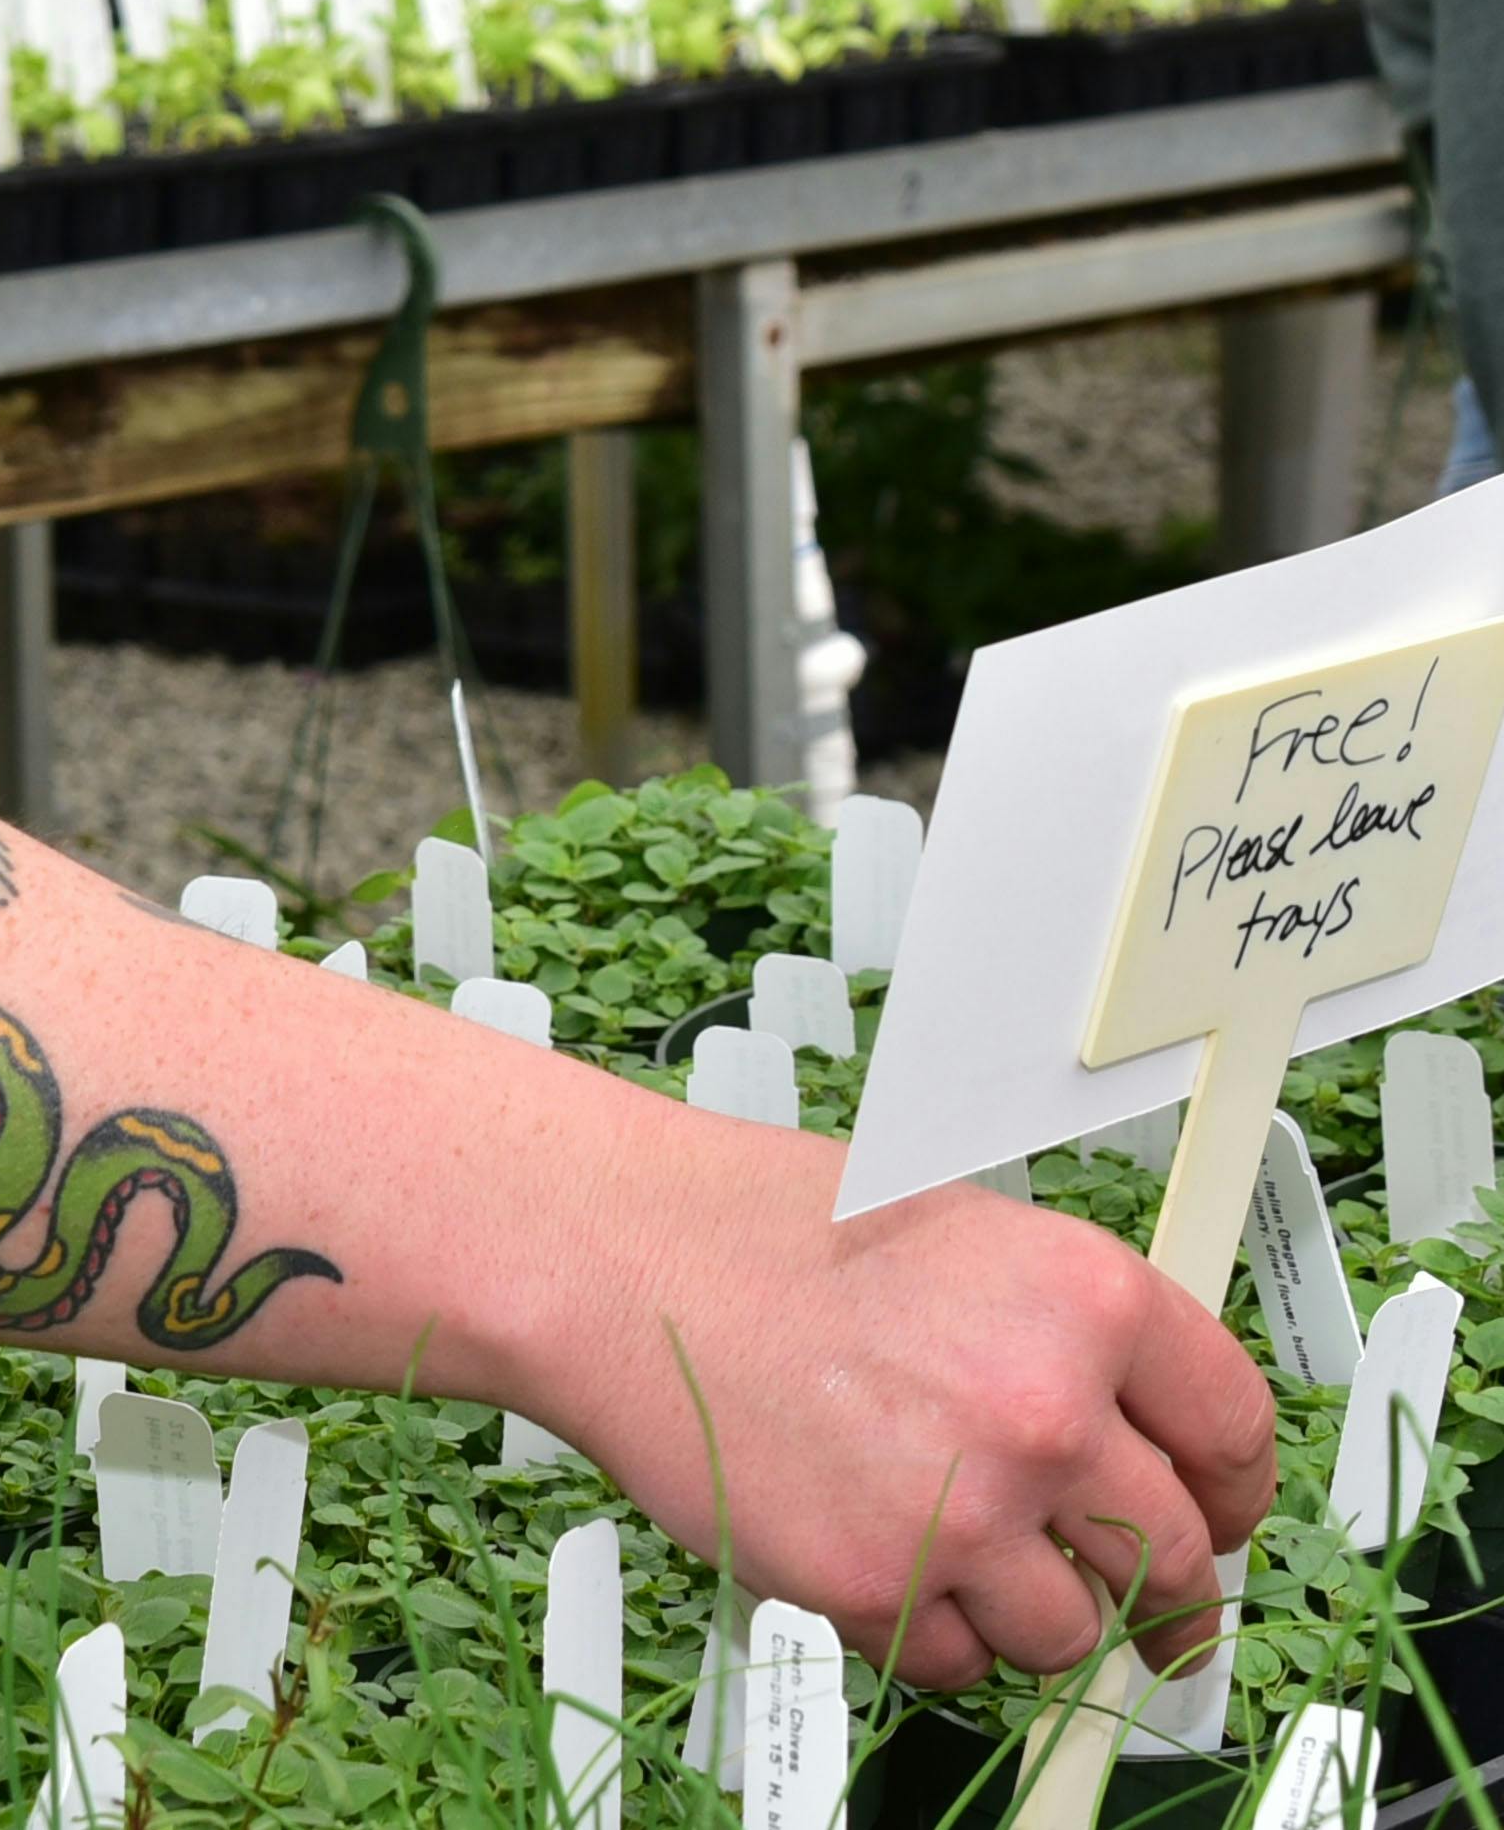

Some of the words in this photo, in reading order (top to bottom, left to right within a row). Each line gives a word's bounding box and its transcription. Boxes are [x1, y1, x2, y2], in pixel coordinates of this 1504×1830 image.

[1235, 656, 1440, 804] Free!
[1164, 814, 1304, 932] Please
[1309, 781, 1436, 857] leave
[1234, 876, 1361, 970] trays
[1263, 1180, 1284, 1223] Italian
[1278, 1228, 1302, 1285] Oregano
[1265, 1243, 1287, 1280] dried
[1292, 1335, 1317, 1390] butterfl
[791, 1639, 805, 1687] Herb
[788, 1707, 805, 1773] Chives
